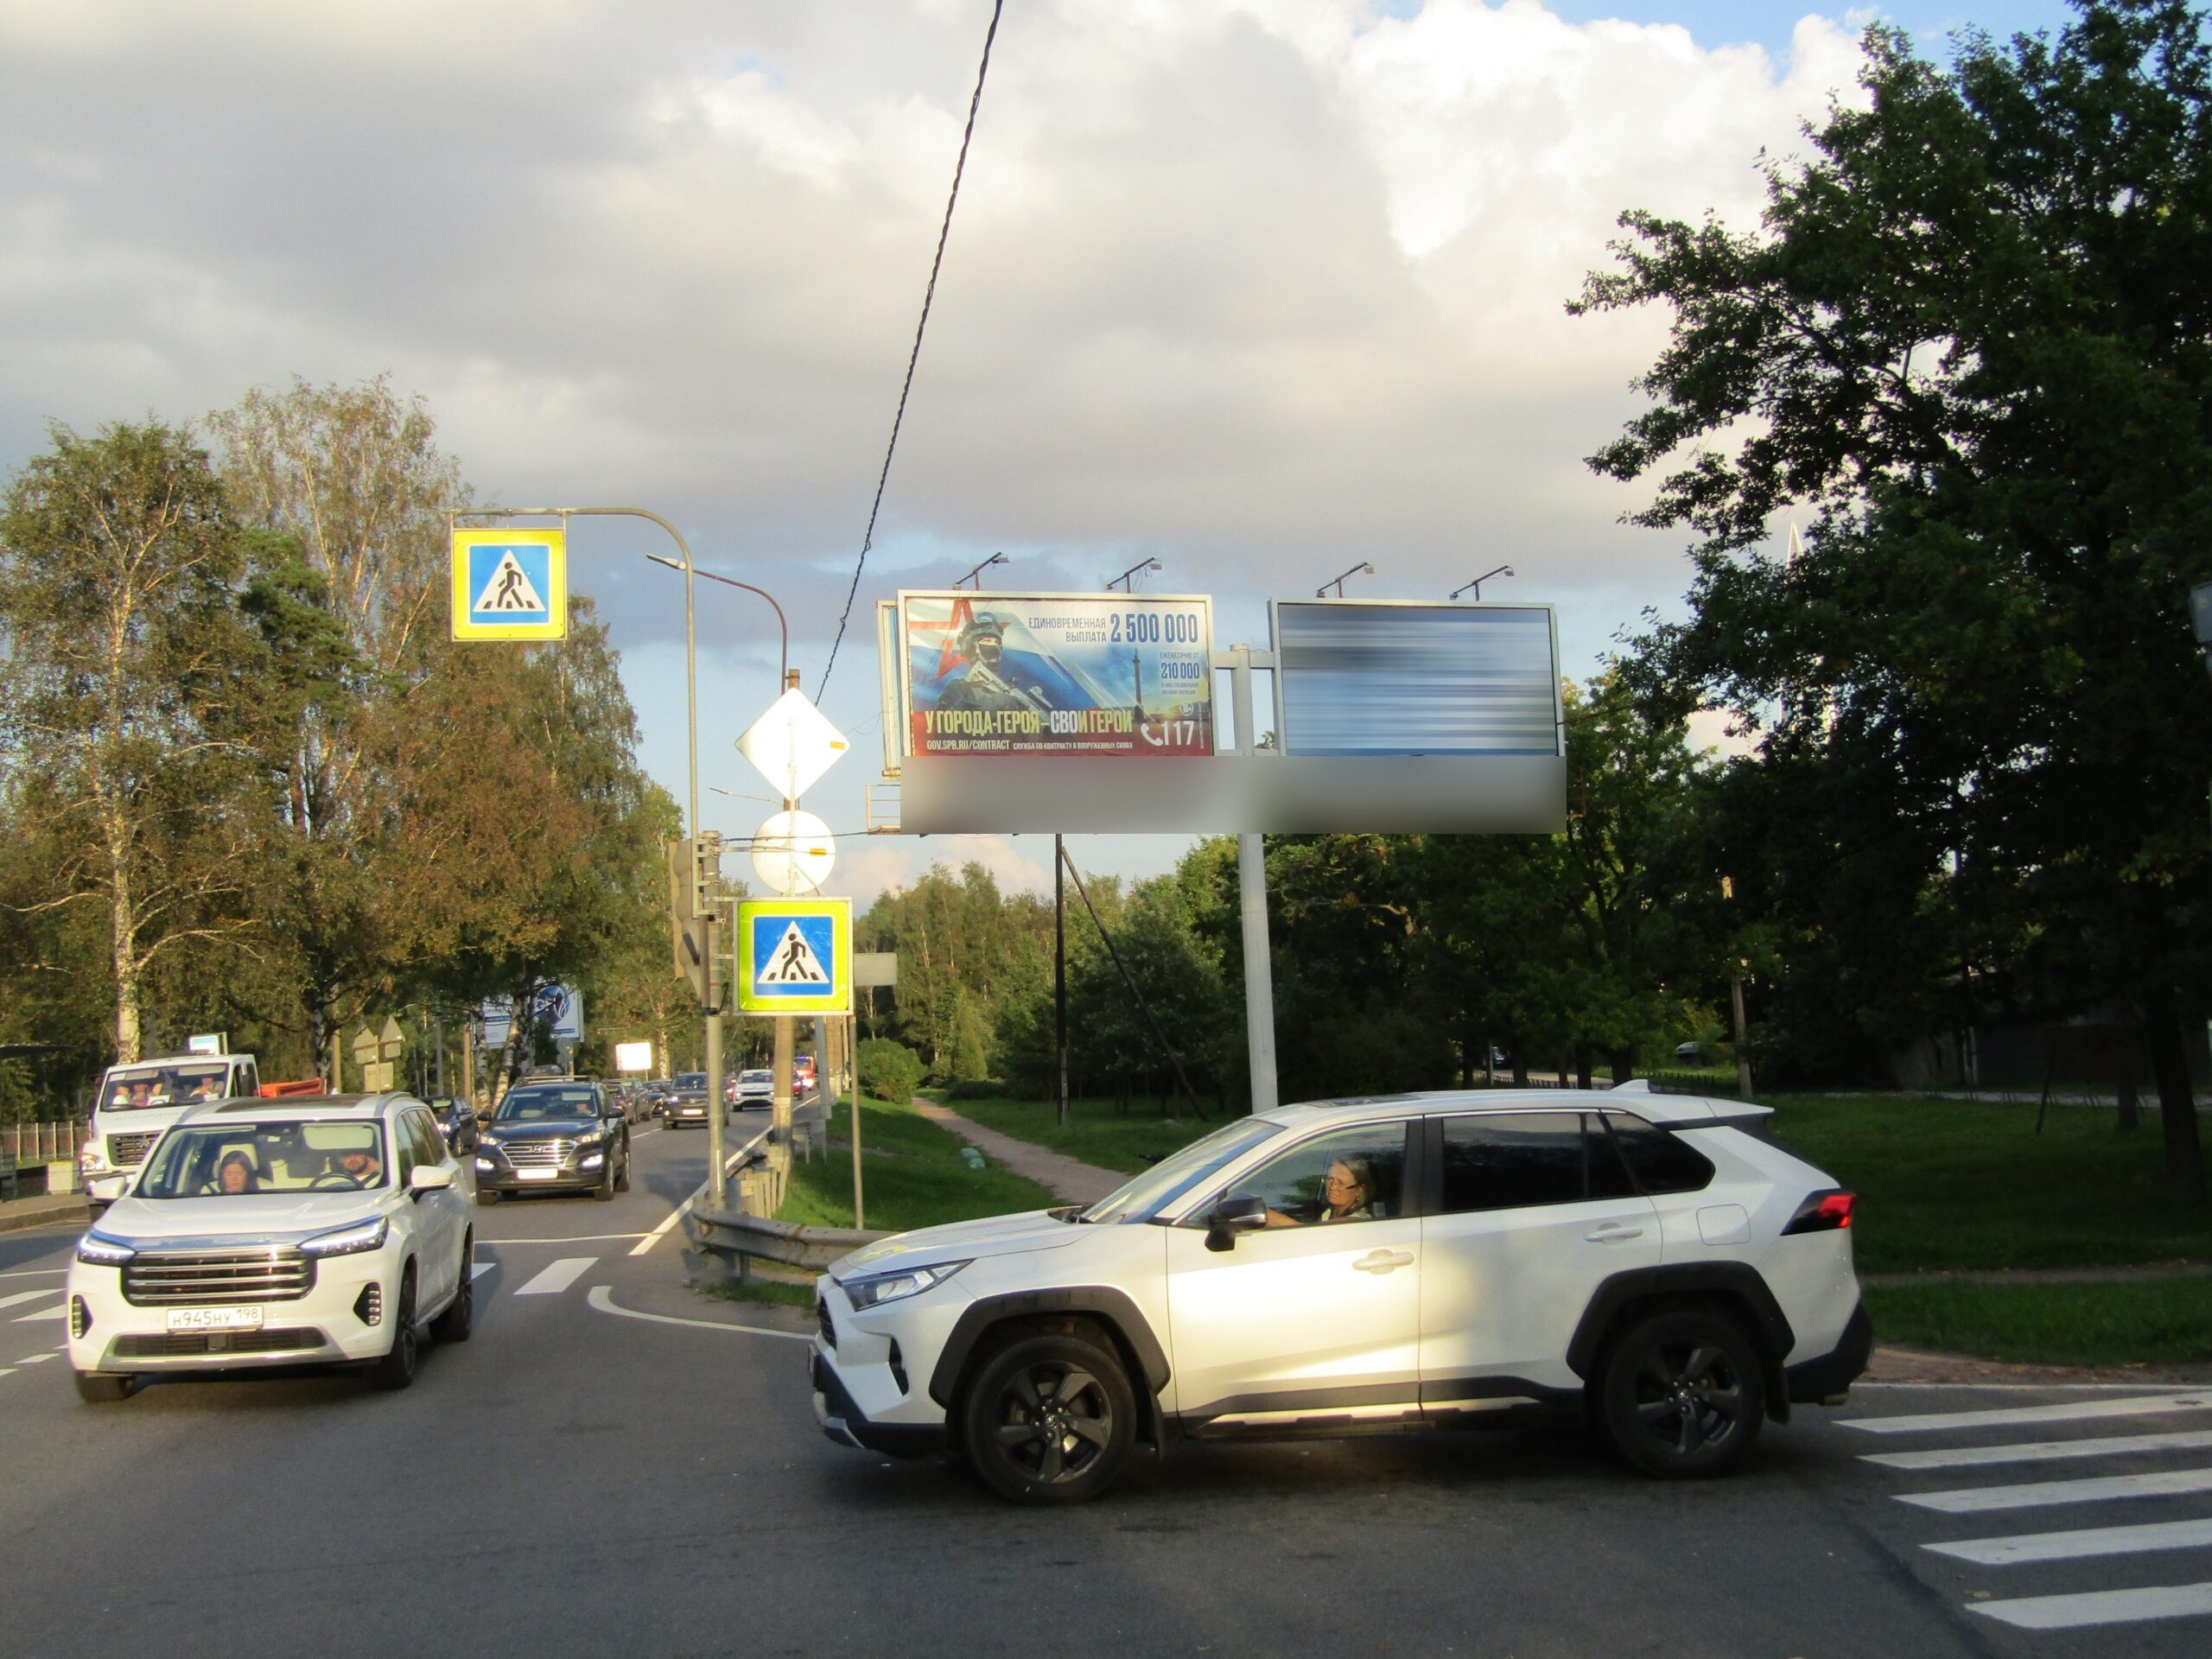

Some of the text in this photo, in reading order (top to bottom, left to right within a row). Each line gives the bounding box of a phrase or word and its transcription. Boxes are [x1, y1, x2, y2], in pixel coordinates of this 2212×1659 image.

[1028, 617, 1106, 629] ЕДИНОВРЕМЕННАЯ
[1110, 613, 1198, 643] 2 500 000
[1065, 632, 1107, 643] ВЫПЛАТА
[1160, 662, 1200, 679] 210 000
[925, 710, 934, 734] У
[937, 710, 1040, 736] ГОРОДА-ГЕРОЯ
[1050, 710, 1087, 734] СВОИ
[1090, 710, 1133, 734] ГЕРОИ
[1161, 721, 1195, 746] 117
[926, 740, 1010, 750] GOV.SPB.RU/CONTRACT
[236, 1307, 259, 1319] 198
